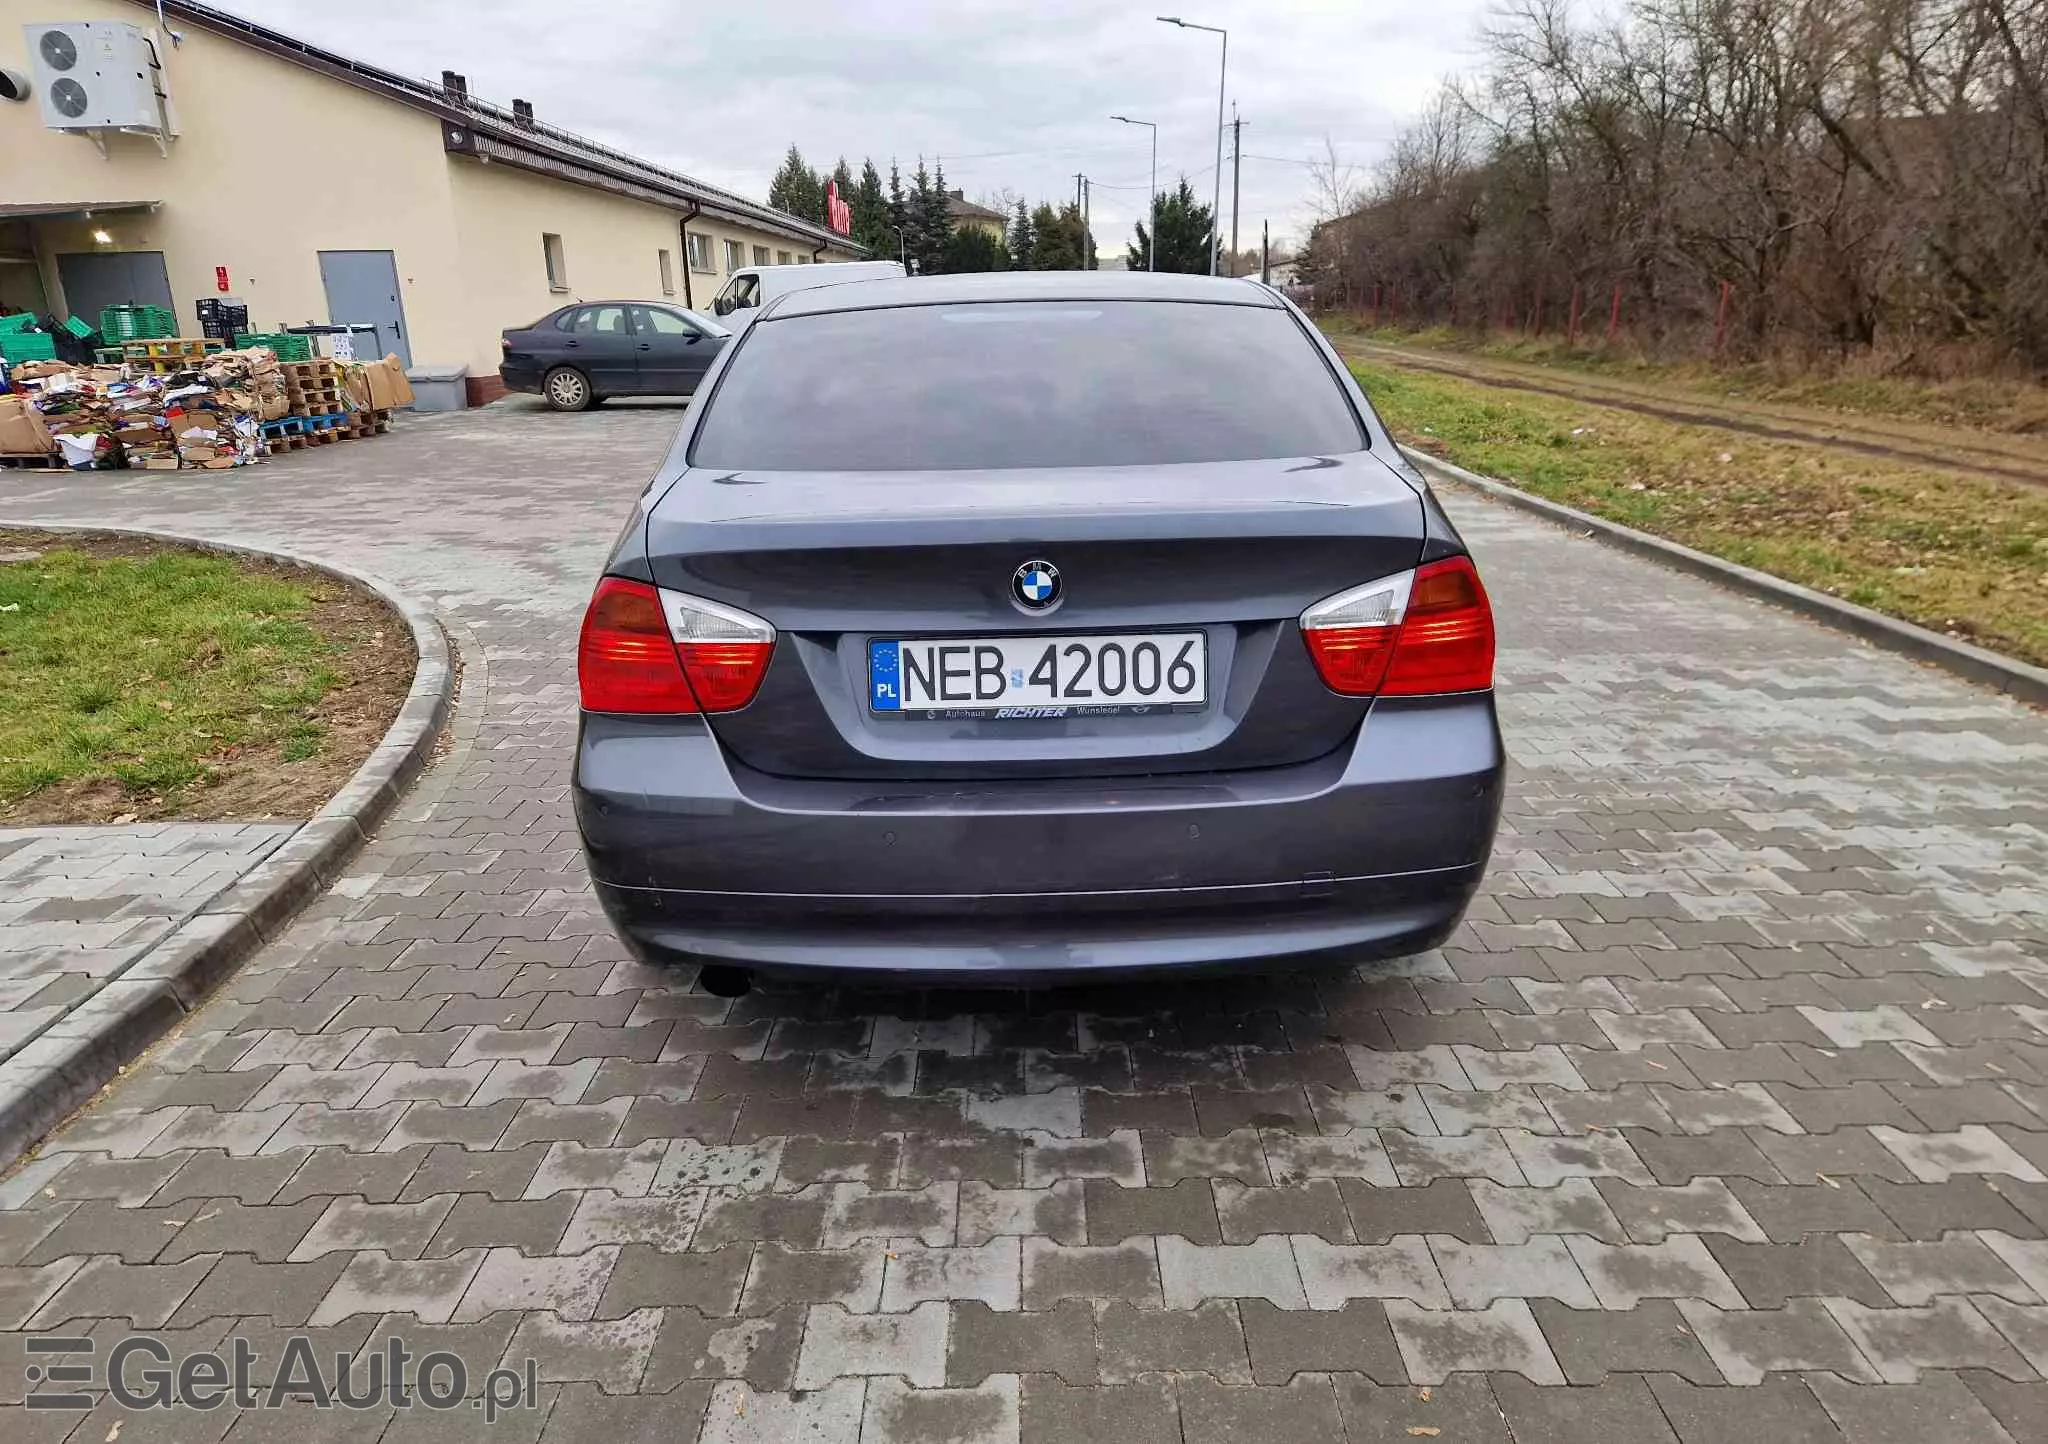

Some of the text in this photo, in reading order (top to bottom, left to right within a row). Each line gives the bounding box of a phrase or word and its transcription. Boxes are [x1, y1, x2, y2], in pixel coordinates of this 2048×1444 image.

[1017, 561, 1057, 578] BMW
[902, 640, 1196, 702] NEB 42006
[876, 683, 897, 698] PL
[945, 709, 986, 719] Autohaus
[994, 706, 1068, 720] RICHTER
